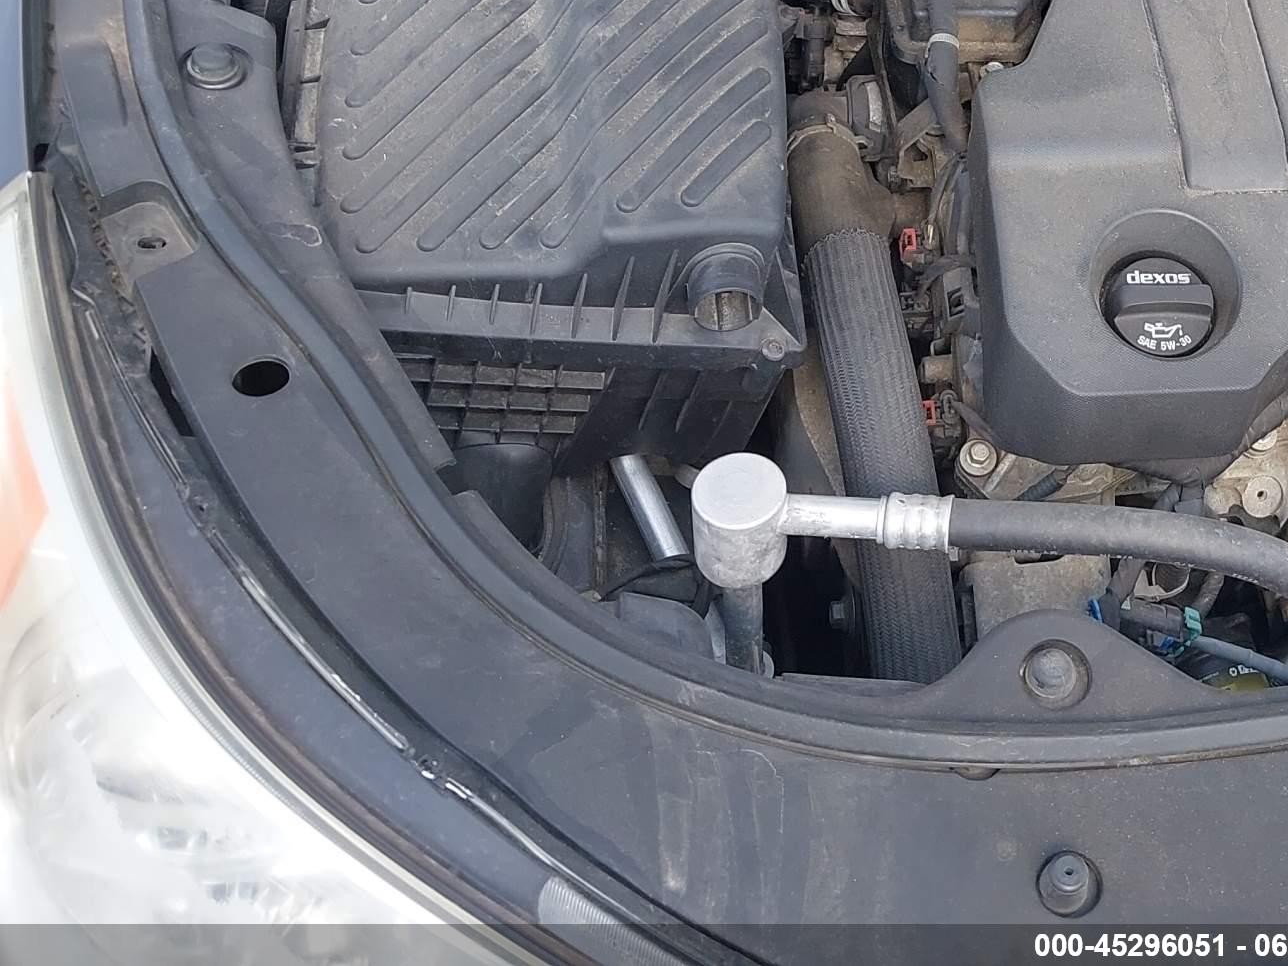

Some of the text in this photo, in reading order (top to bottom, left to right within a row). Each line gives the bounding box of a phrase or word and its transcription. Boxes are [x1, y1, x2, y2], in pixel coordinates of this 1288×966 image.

[1126, 270, 1192, 284] dexos
[1137, 335, 1192, 351] SAE 5W-30
